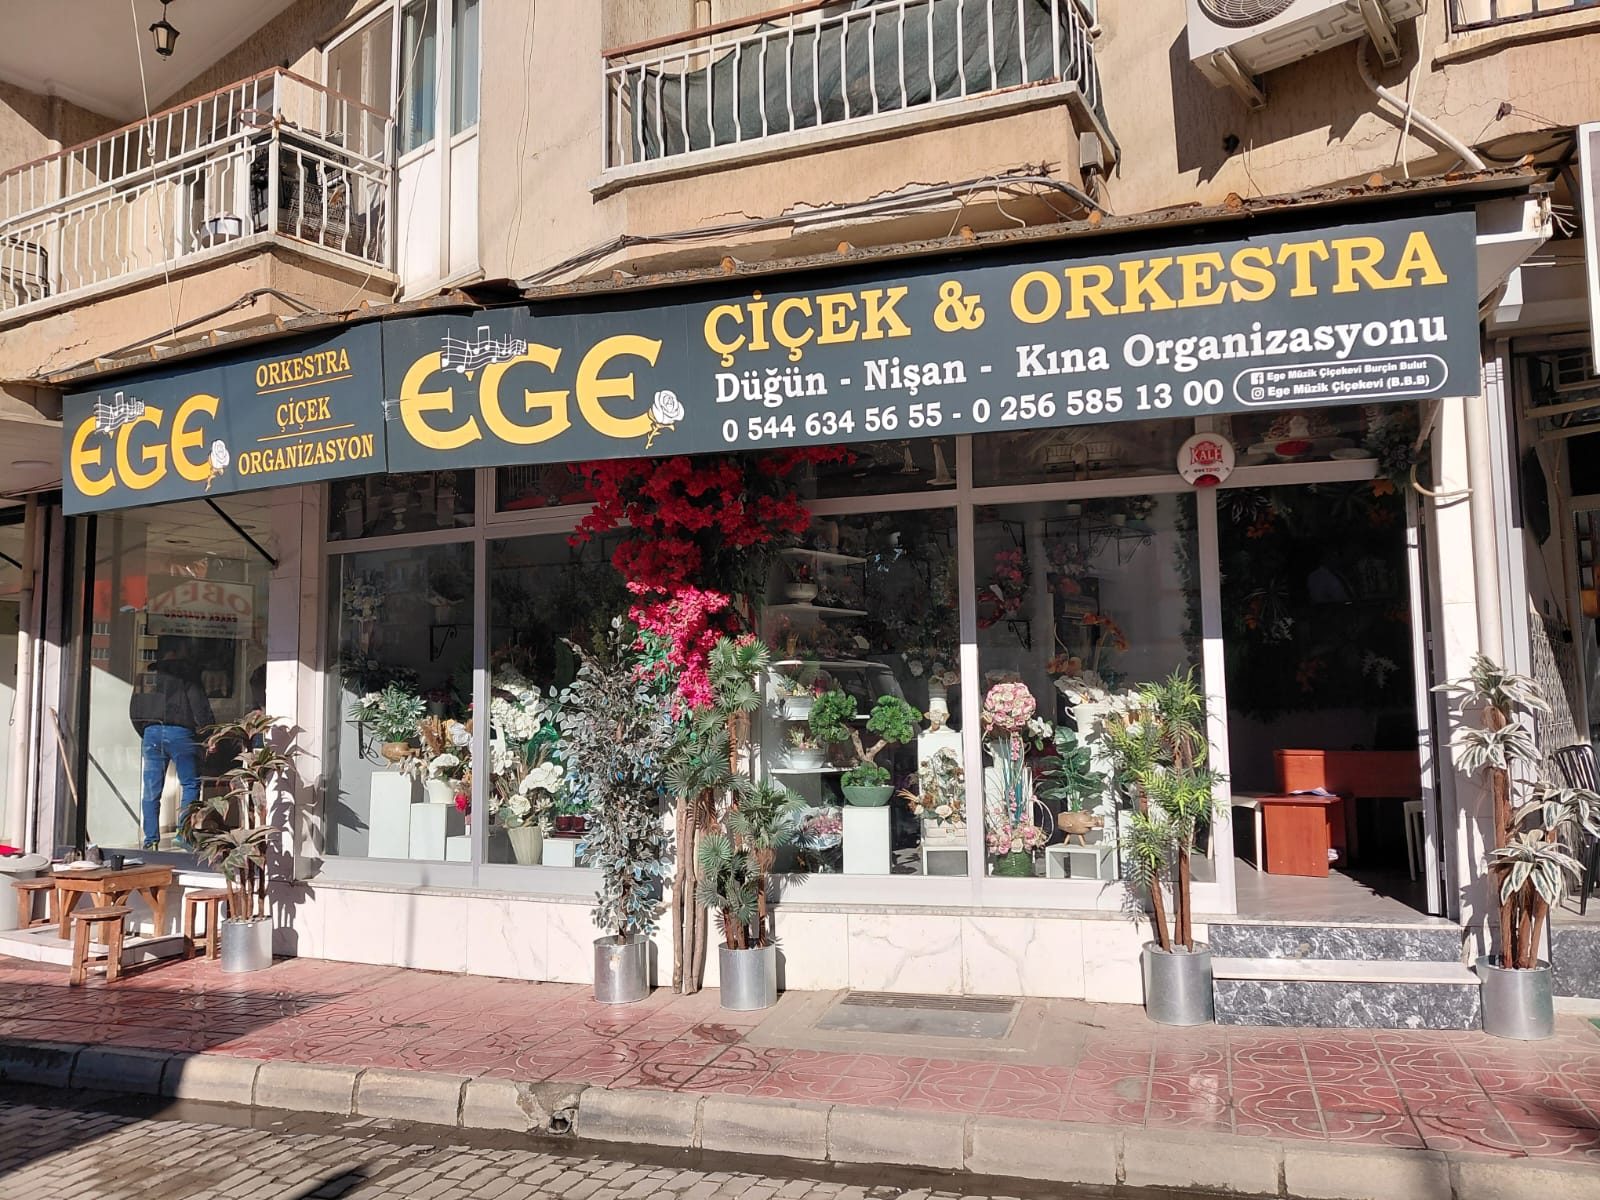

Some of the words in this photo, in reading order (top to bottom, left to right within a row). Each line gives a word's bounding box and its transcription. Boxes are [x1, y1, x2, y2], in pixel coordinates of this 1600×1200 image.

[704, 287, 911, 368] ÇİÇEK
[935, 280, 984, 332] &
[1011, 230, 1449, 324] ORKESTRA
[255, 349, 350, 387] ORKESTRA
[715, 367, 829, 408] Düğün
[840, 377, 851, 386] -
[863, 356, 967, 396] Nişan
[980, 365, 992, 373] -
[1015, 343, 1111, 378] Kına
[1123, 316, 1448, 373] Organizasyonu
[1267, 371, 1286, 382] Ege
[1288, 368, 1318, 380] Müzik
[1319, 365, 1363, 379] Çiçekevi
[1364, 362, 1398, 376] Burçin
[1400, 360, 1428, 371] Bulut
[400, 336, 662, 450] EGE
[1267, 386, 1290, 399] Ege
[1293, 383, 1329, 396] Müzik
[1332, 378, 1384, 394] Çiçekevi
[1387, 374, 1431, 389] (B.B.B)
[276, 396, 332, 434] ÇİÇEK
[722, 419, 739, 443] 0
[747, 414, 797, 441] 544
[805, 409, 856, 437] 634
[864, 405, 899, 432] 56
[908, 401, 943, 429] 55
[972, 398, 991, 424] 0
[1000, 392, 1056, 421] 256
[1066, 386, 1123, 416] 585
[1136, 382, 1173, 411] 13
[1183, 378, 1224, 407] 00
[69, 393, 220, 497] EGE
[238, 433, 376, 476] ORGANİZASYON
[1189, 445, 1224, 465] KALE
